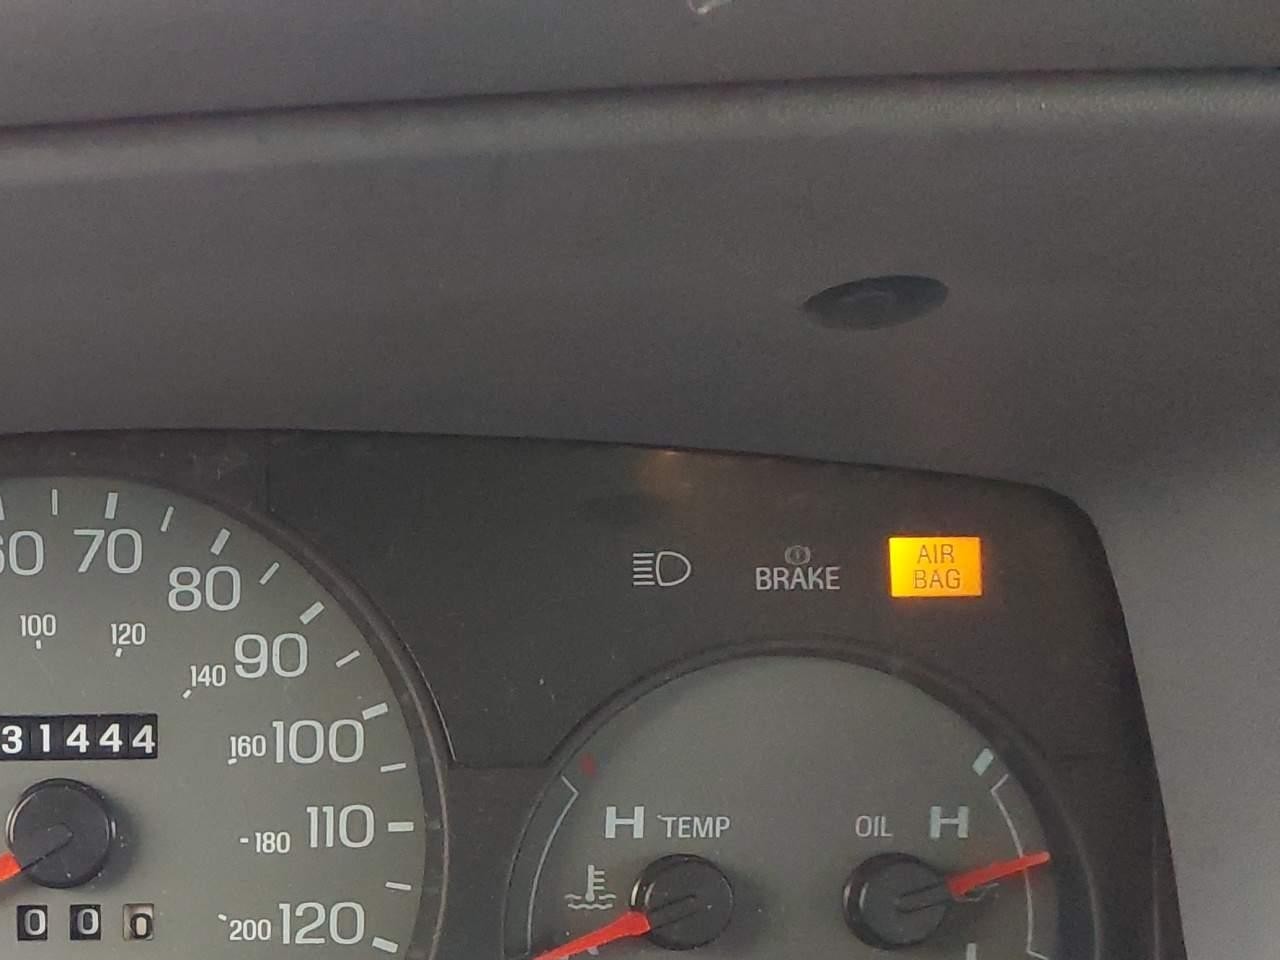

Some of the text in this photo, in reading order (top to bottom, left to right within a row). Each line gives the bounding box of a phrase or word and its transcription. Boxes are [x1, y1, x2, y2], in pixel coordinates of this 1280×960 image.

[74, 528, 144, 574] 70
[916, 543, 956, 565] AIR
[167, 567, 241, 612] 80
[754, 566, 841, 592] BRAKE
[913, 568, 962, 591] BAG
[19, 614, 58, 640] 100
[110, 622, 146, 647] 120
[234, 634, 308, 679] 90
[189, 664, 226, 689] 140
[231, 734, 267, 758] 160
[273, 720, 365, 764] 100
[306, 805, 375, 848] 110
[604, 806, 645, 839] H
[664, 816, 731, 839] TEMP
[855, 815, 893, 838] OIL
[929, 806, 969, 839] H
[254, 830, 291, 855] 180
[229, 917, 272, 942] 200
[279, 901, 366, 945] 120
